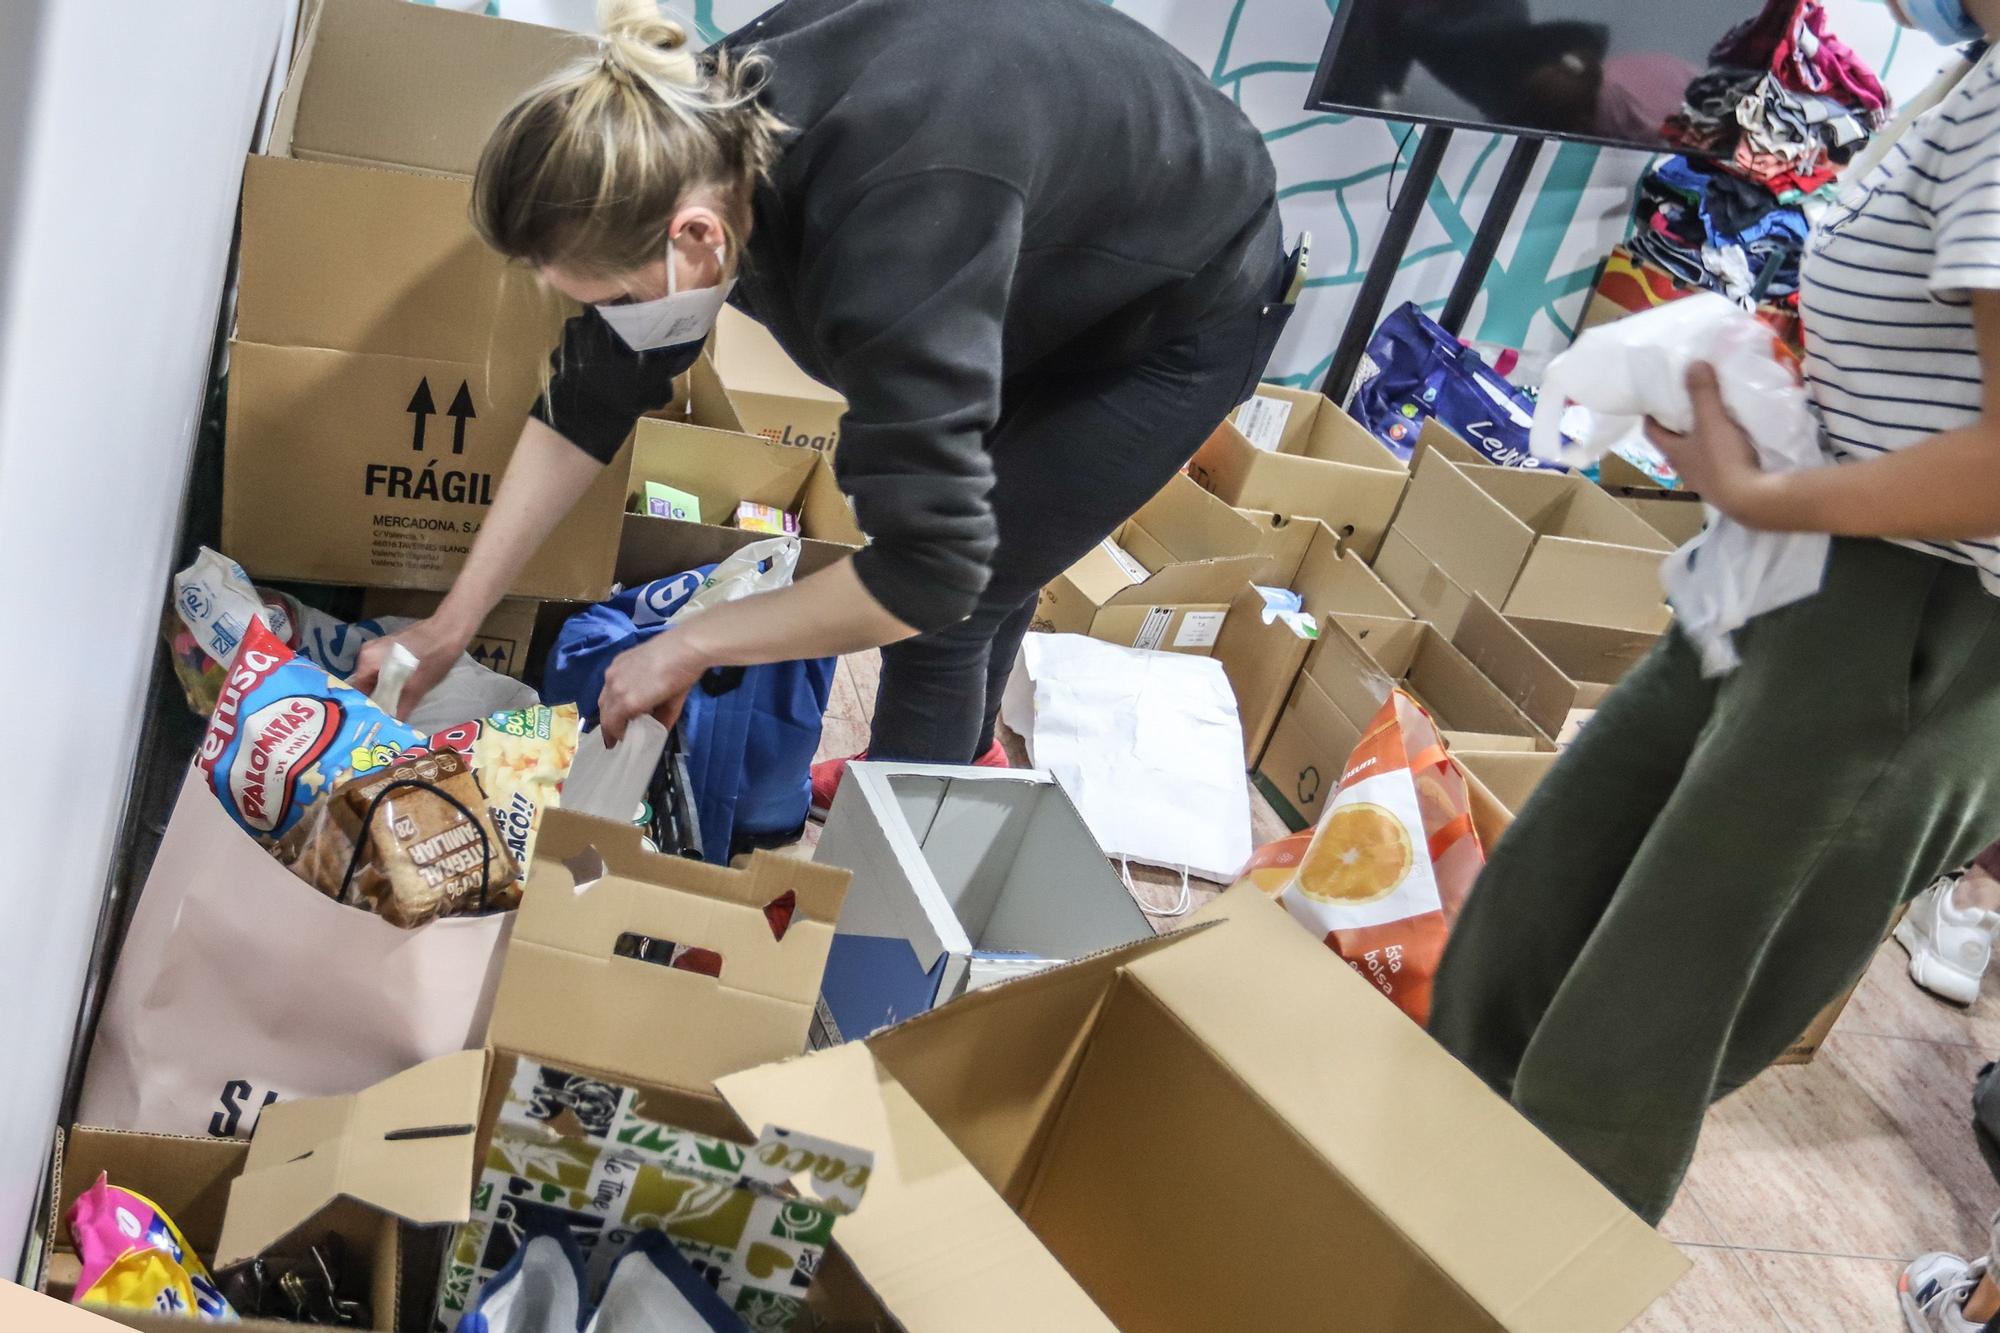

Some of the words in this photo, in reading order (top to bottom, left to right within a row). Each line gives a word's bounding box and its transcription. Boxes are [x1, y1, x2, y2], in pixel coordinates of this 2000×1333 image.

[373, 515, 459, 533] MERCADONA,
[242, 701, 317, 819] PALOMITAS
[395, 819, 414, 837] 28
[1363, 949, 1393, 995] bolsa
[1385, 943, 1404, 974] Esta
[208, 1080, 278, 1137] S
